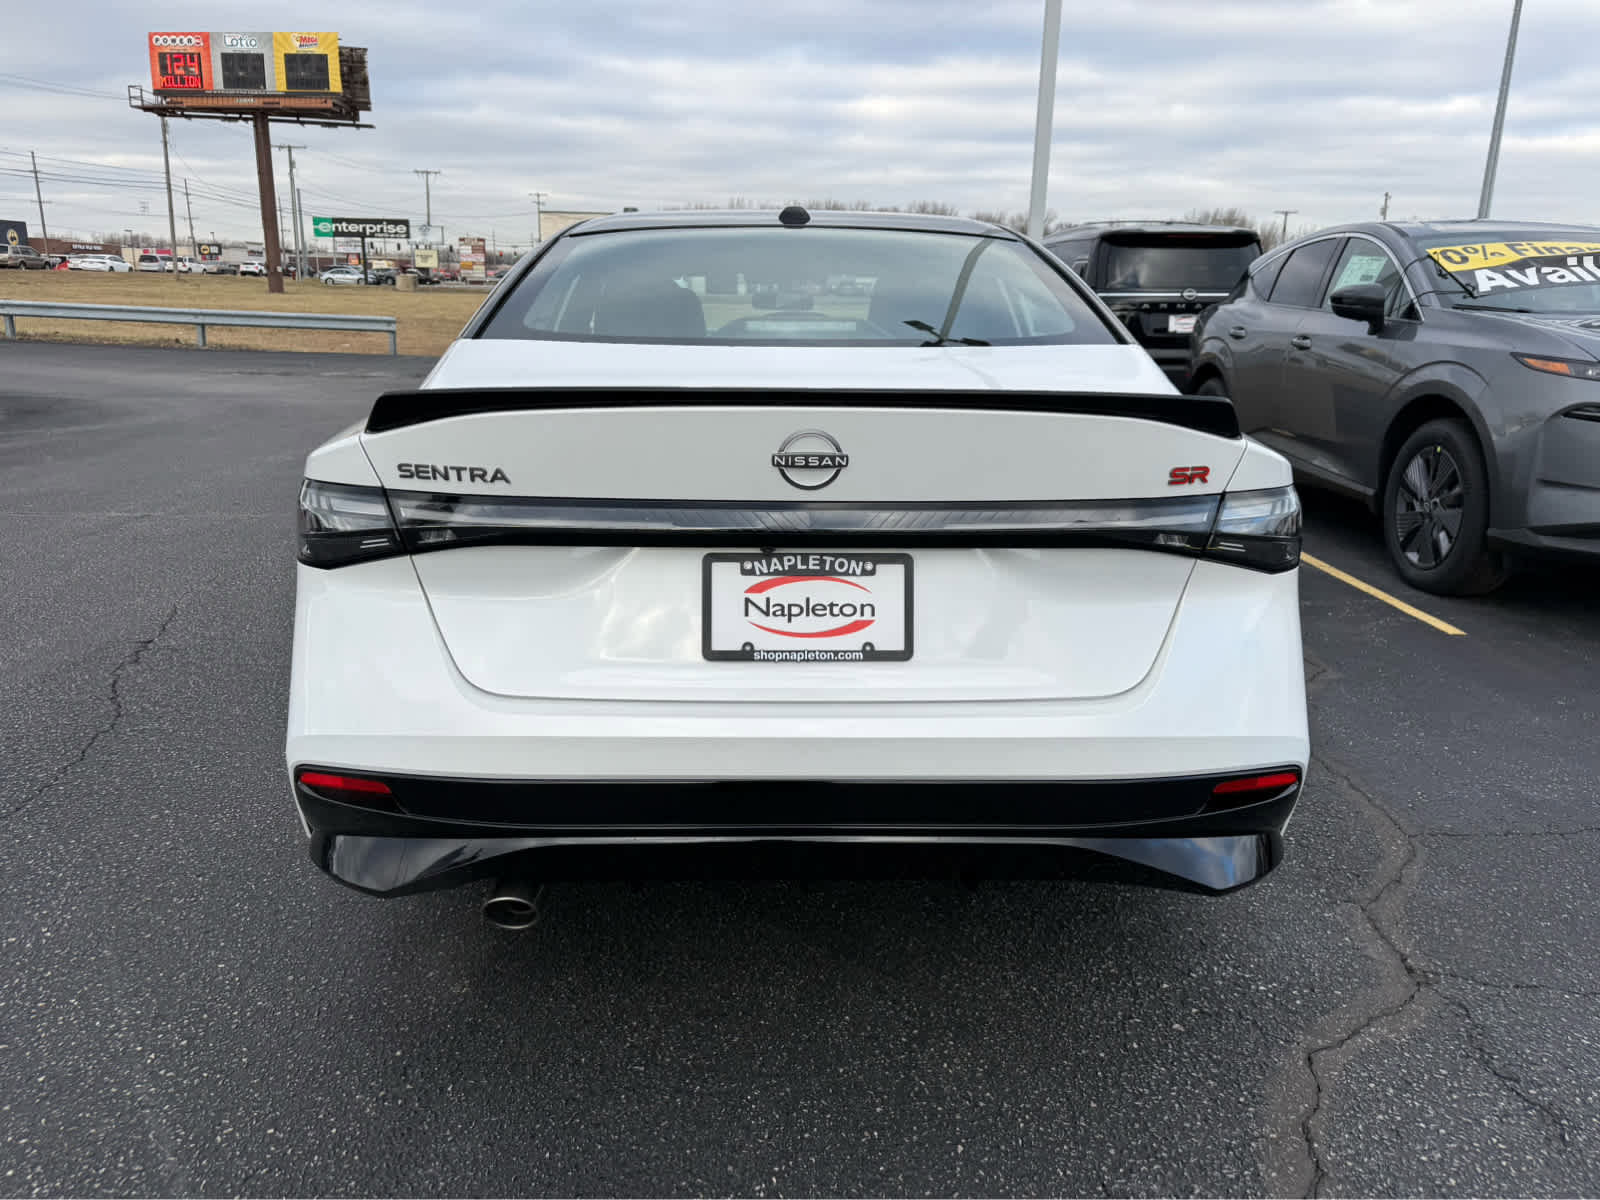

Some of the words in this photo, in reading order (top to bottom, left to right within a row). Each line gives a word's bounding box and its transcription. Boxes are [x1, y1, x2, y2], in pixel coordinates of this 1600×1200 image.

[167, 54, 199, 75] 124
[160, 76, 201, 88] MILLION
[319, 221, 407, 236] enterprise
[1438, 244, 1506, 266] 0%
[774, 455, 848, 466] NISSAN
[396, 462, 512, 485] SENTRA
[1167, 465, 1211, 486] SR
[752, 555, 864, 576] NAPLETON
[743, 596, 876, 624] Napleton
[753, 650, 864, 662] shopnapleton.com
